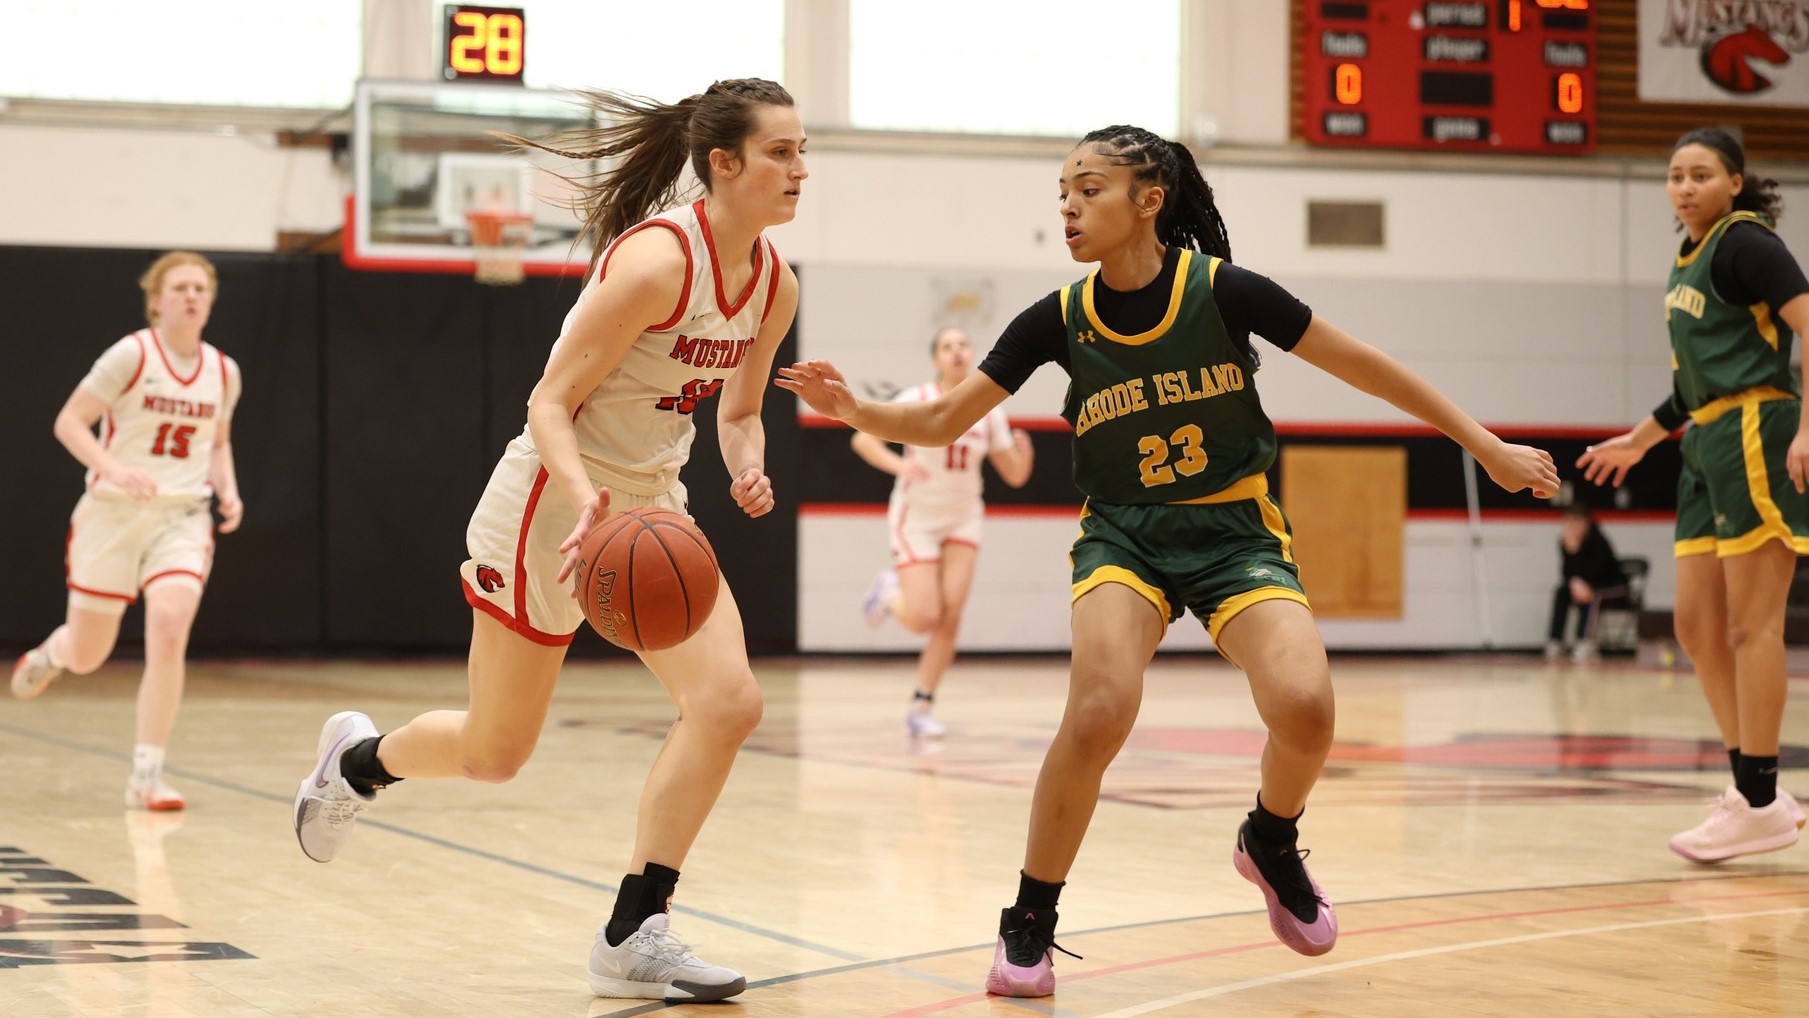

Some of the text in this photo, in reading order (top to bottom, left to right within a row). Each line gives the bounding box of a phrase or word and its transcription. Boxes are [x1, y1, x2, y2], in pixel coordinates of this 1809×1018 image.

[451, 12, 523, 75] 28
[1336, 64, 1361, 104] 0
[1558, 73, 1582, 113] 0
[1152, 362, 1245, 406] ISLAND
[151, 422, 197, 459] 15
[1137, 423, 1209, 488] 23
